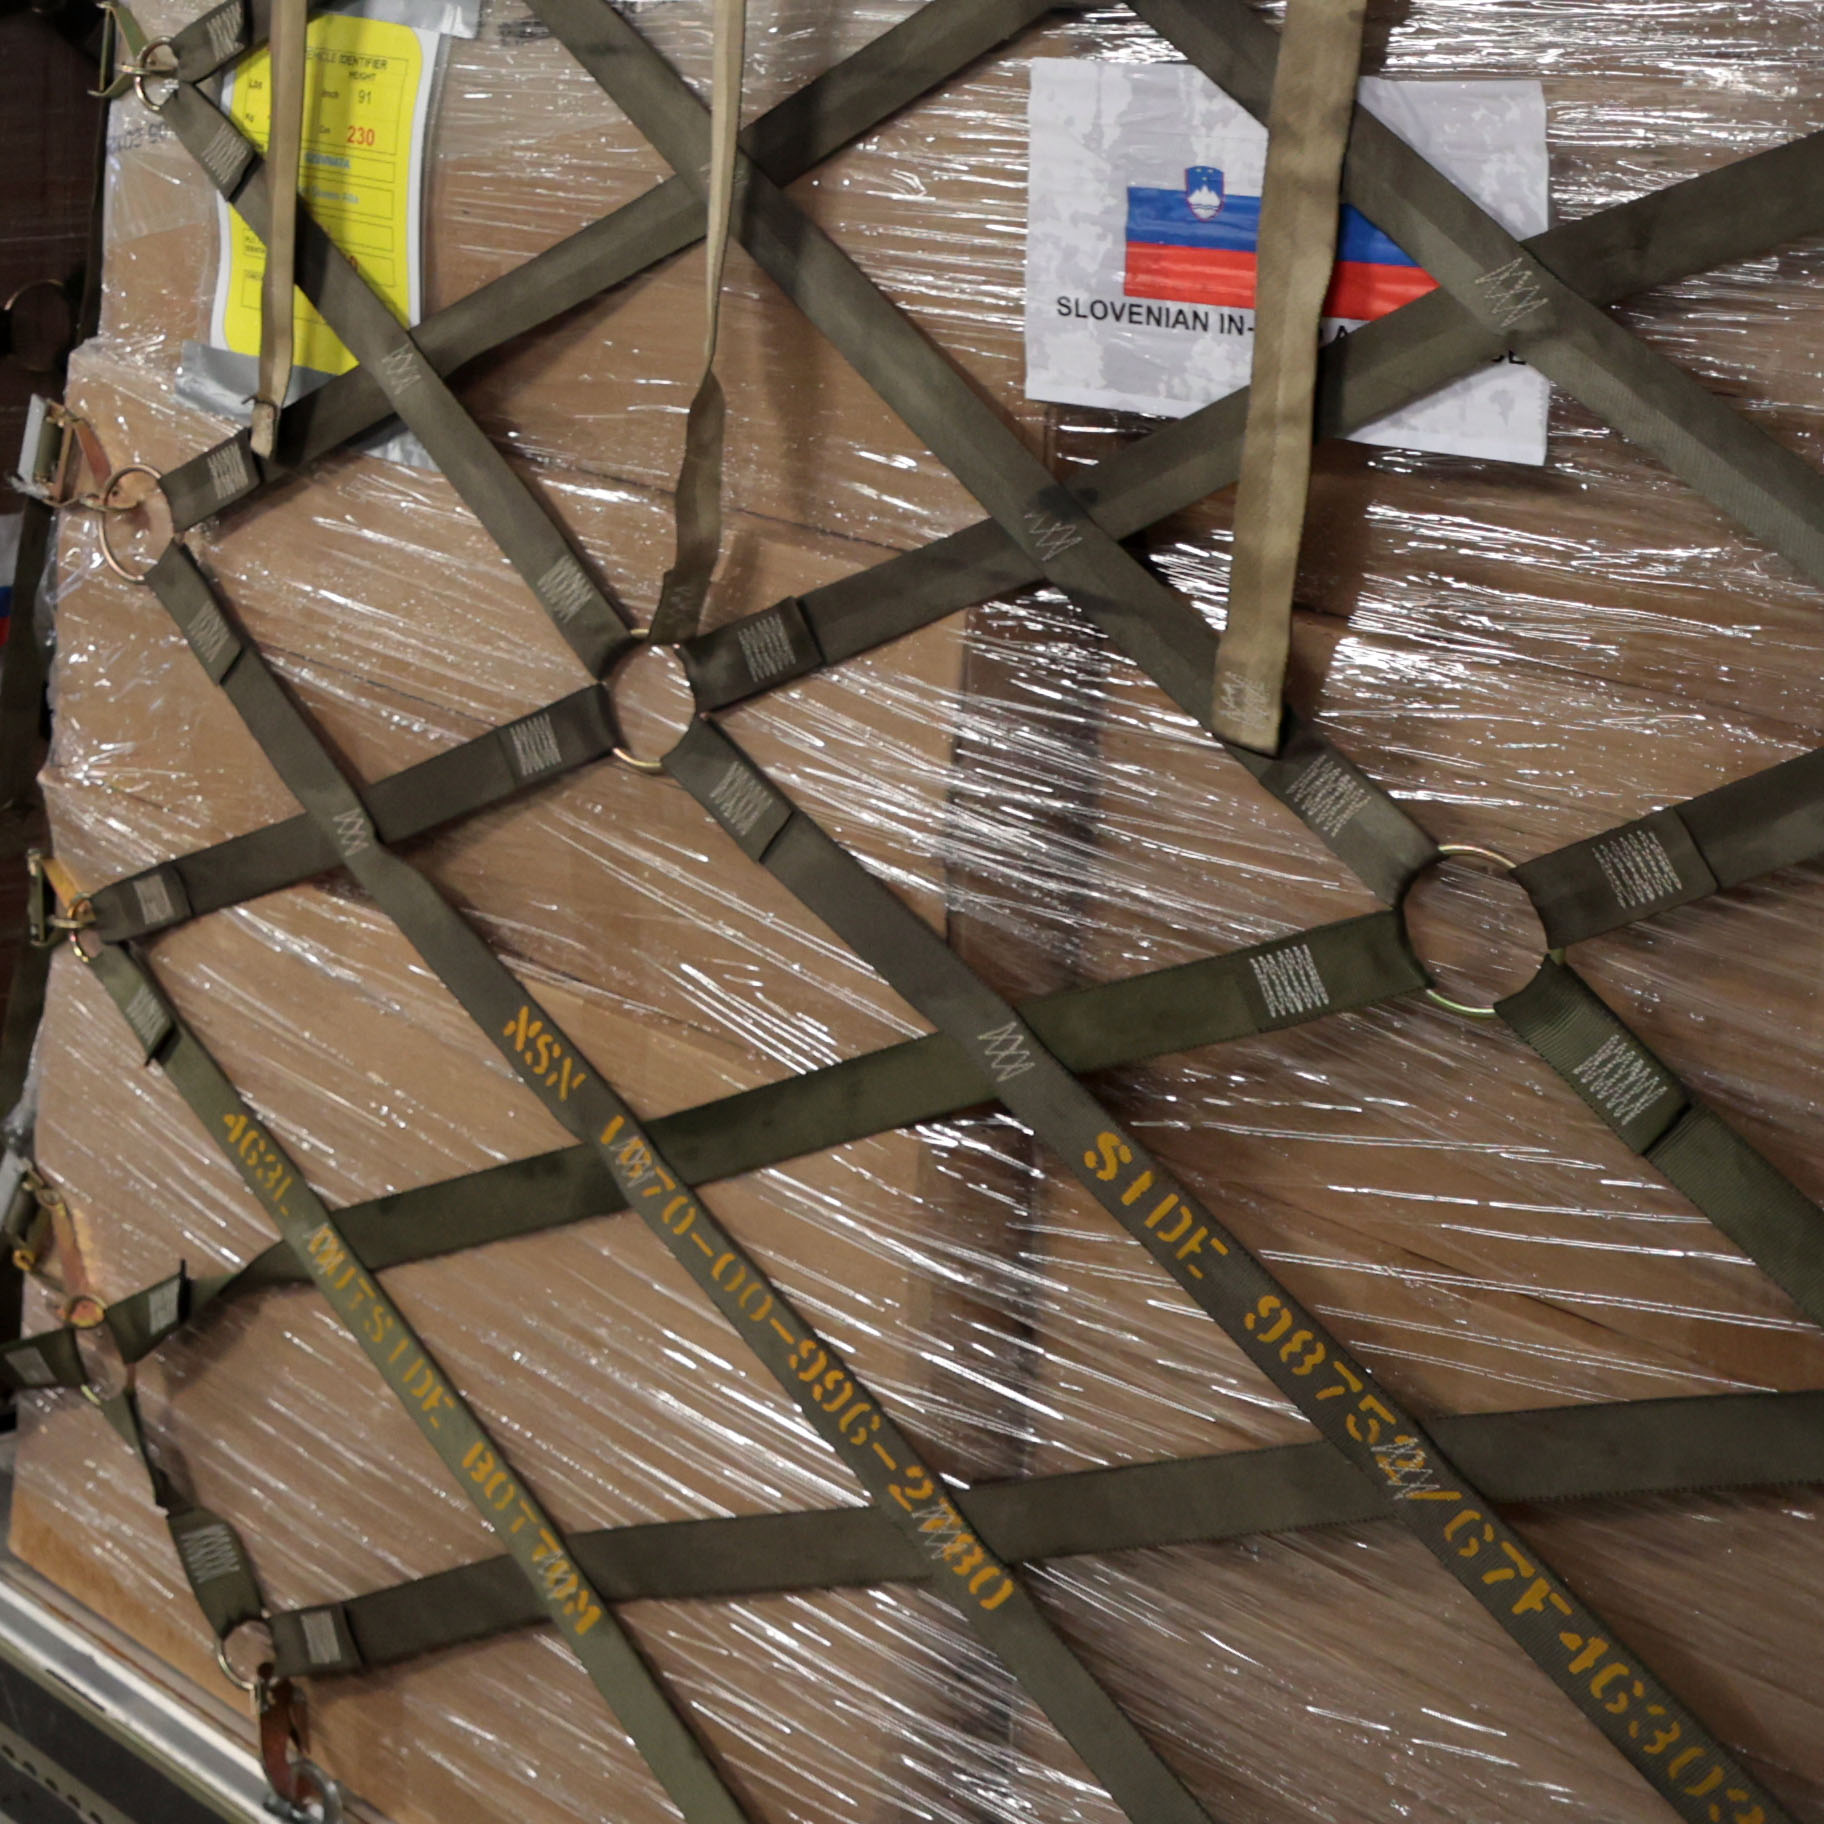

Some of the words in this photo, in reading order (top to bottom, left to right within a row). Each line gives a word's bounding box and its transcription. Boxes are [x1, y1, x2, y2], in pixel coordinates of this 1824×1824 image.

[346, 125, 376, 147] 230
[1056, 295, 1210, 334] SLOVENIAN
[504, 1006, 587, 1102] NSN
[1083, 1131, 1230, 1280] SIDE
[463, 1441, 604, 1637] BOTTOM
